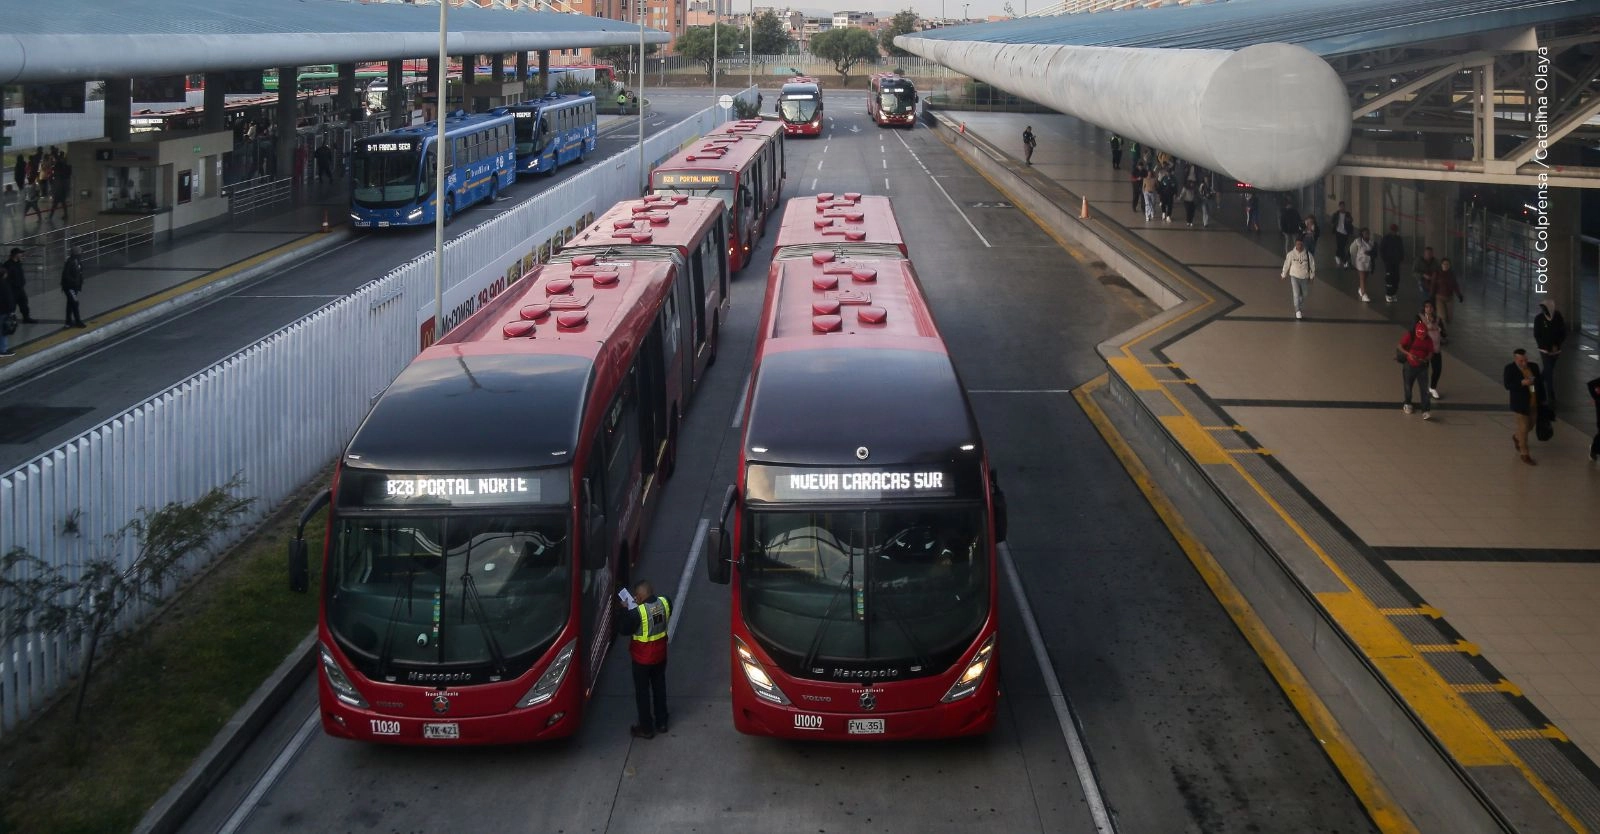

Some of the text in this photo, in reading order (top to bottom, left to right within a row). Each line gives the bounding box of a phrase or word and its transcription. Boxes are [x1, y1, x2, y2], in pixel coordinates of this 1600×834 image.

[679, 175, 700, 183] PORTAL
[701, 175, 720, 183] NORTE
[386, 477, 528, 496] B28 PORTAL NORTE
[790, 472, 943, 490] NUEVA CARACAS SUR
[407, 671, 472, 681] Marcopolo
[833, 668, 898, 678] Marcopolo
[801, 694, 832, 703] VOLVO
[370, 719, 401, 733] T1030
[794, 713, 823, 728] U1009
